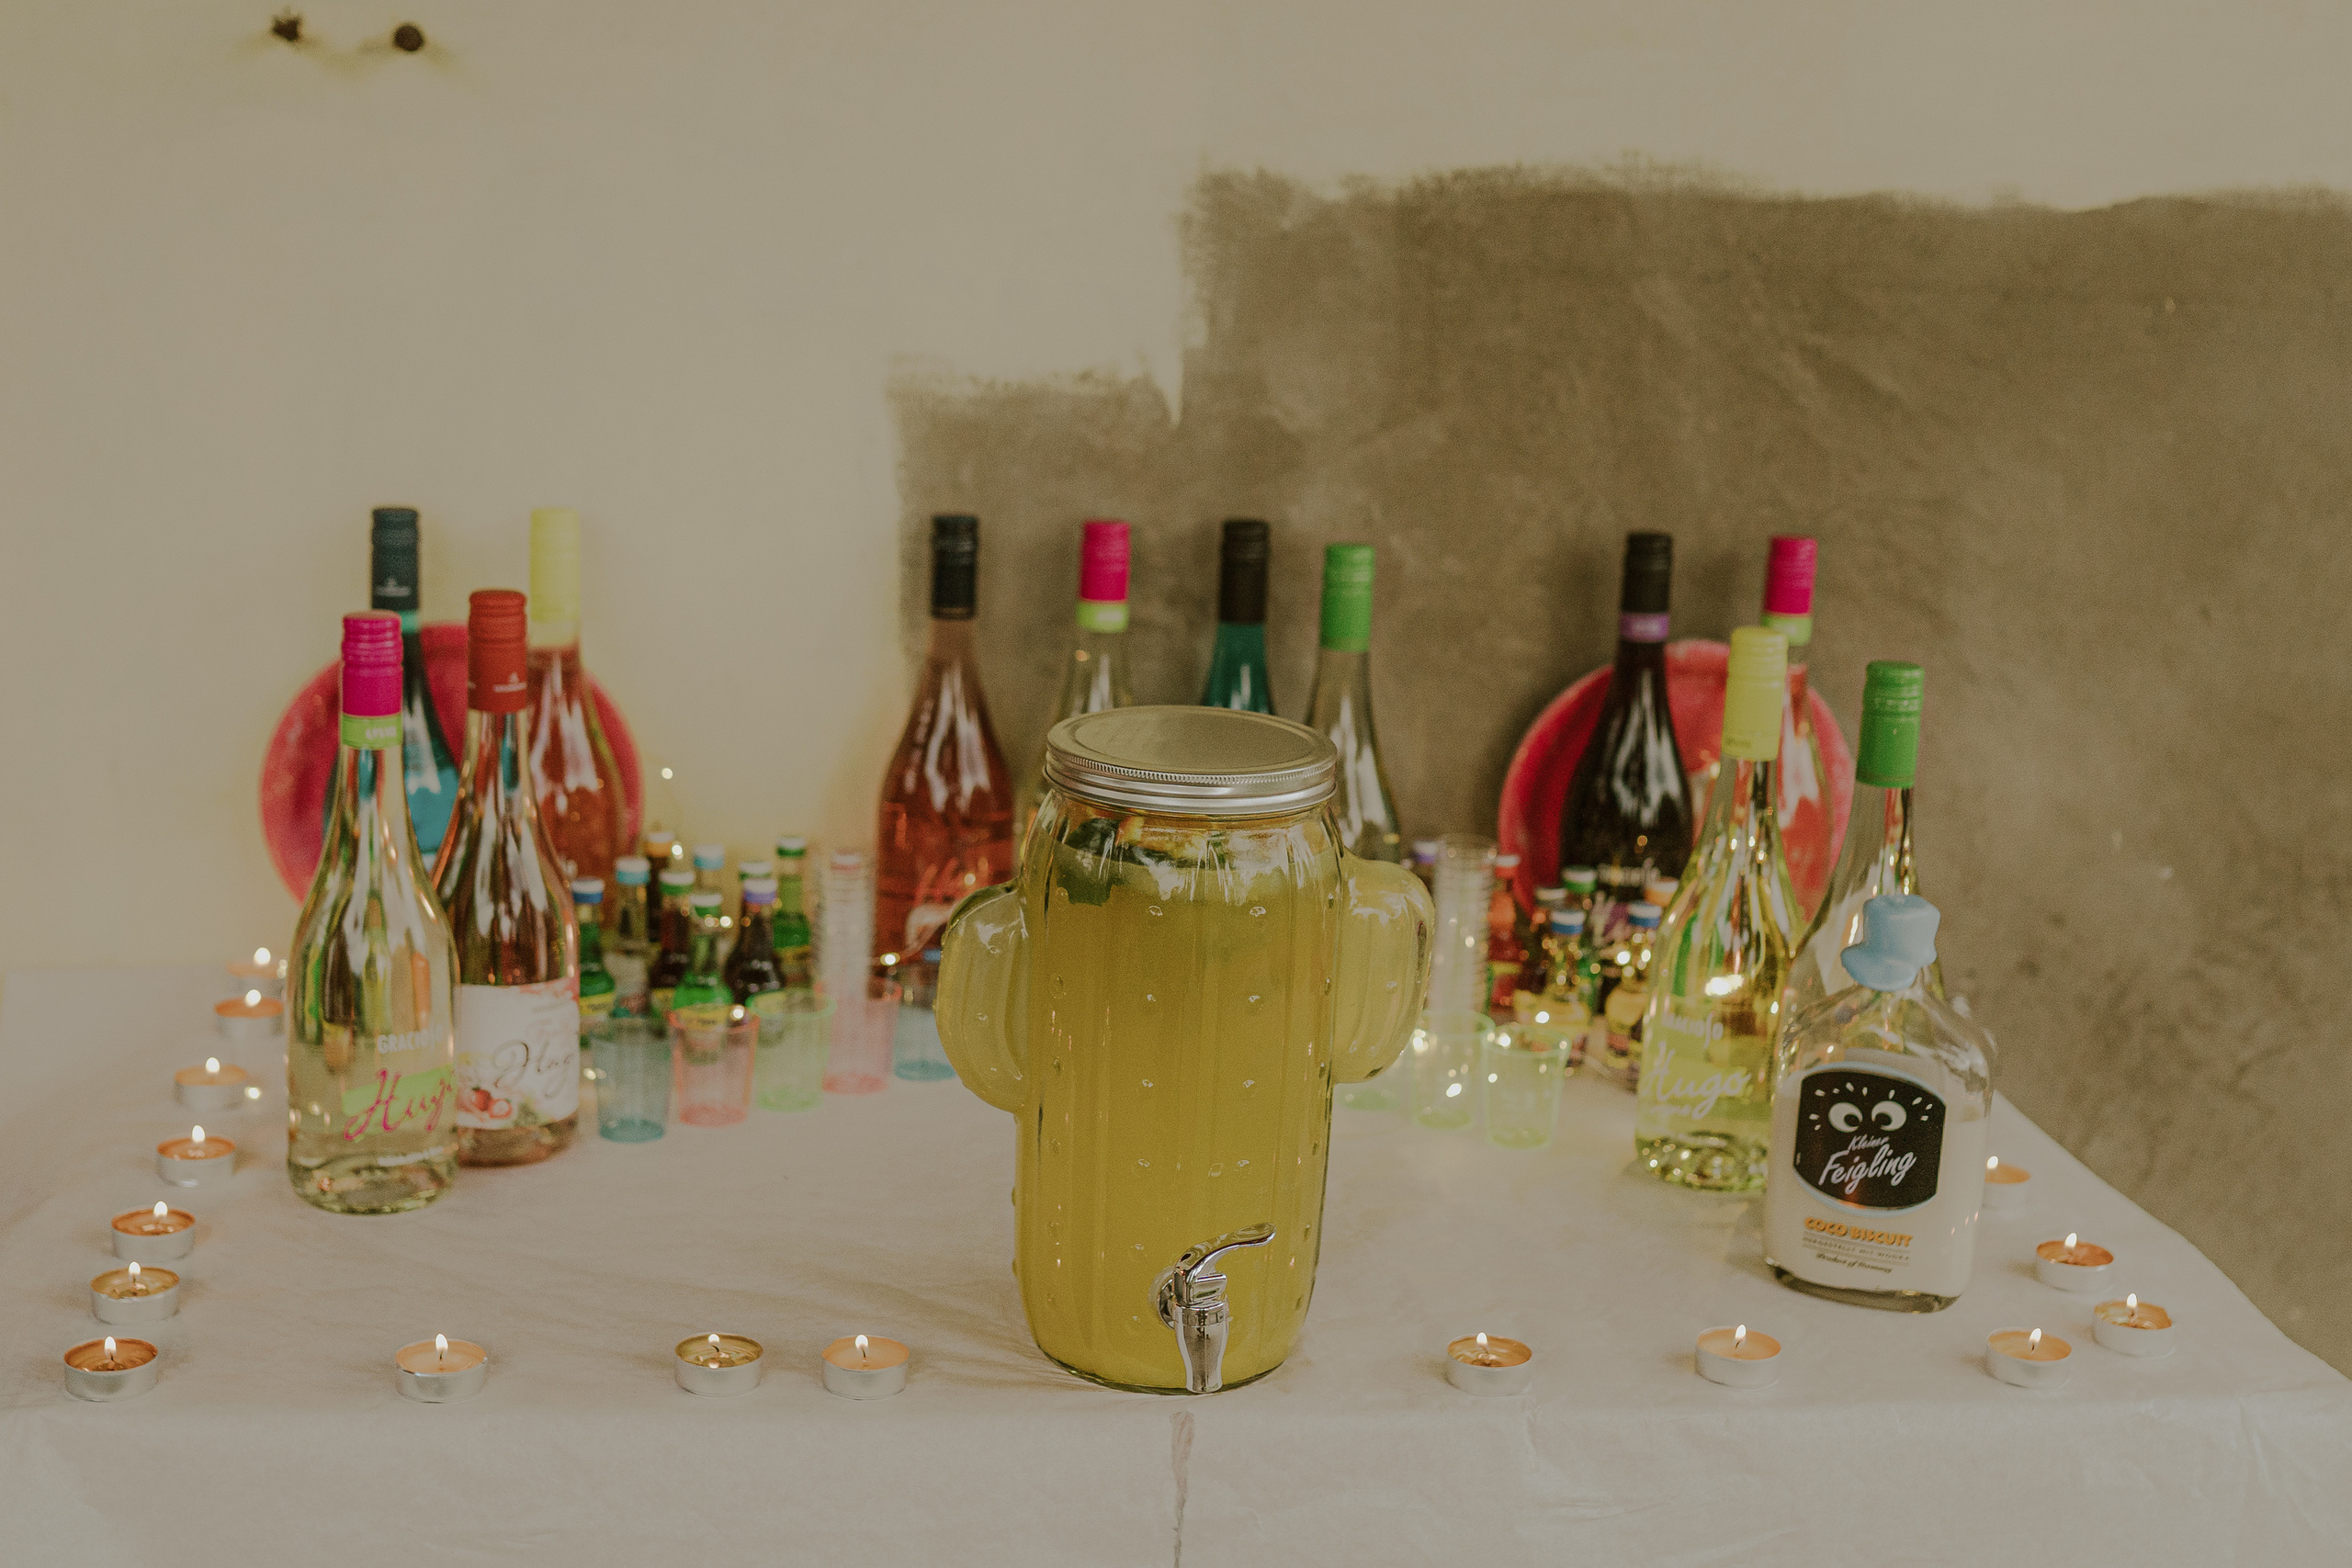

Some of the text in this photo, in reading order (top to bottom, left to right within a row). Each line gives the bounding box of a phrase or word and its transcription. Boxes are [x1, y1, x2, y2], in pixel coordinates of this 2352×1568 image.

[1640, 1040, 1752, 1121] Hugo
[1847, 1134, 1890, 1152] Kleiner
[1818, 1143, 1917, 1194] Feigling
[1804, 1216, 1914, 1247] COCO BISCUIT
